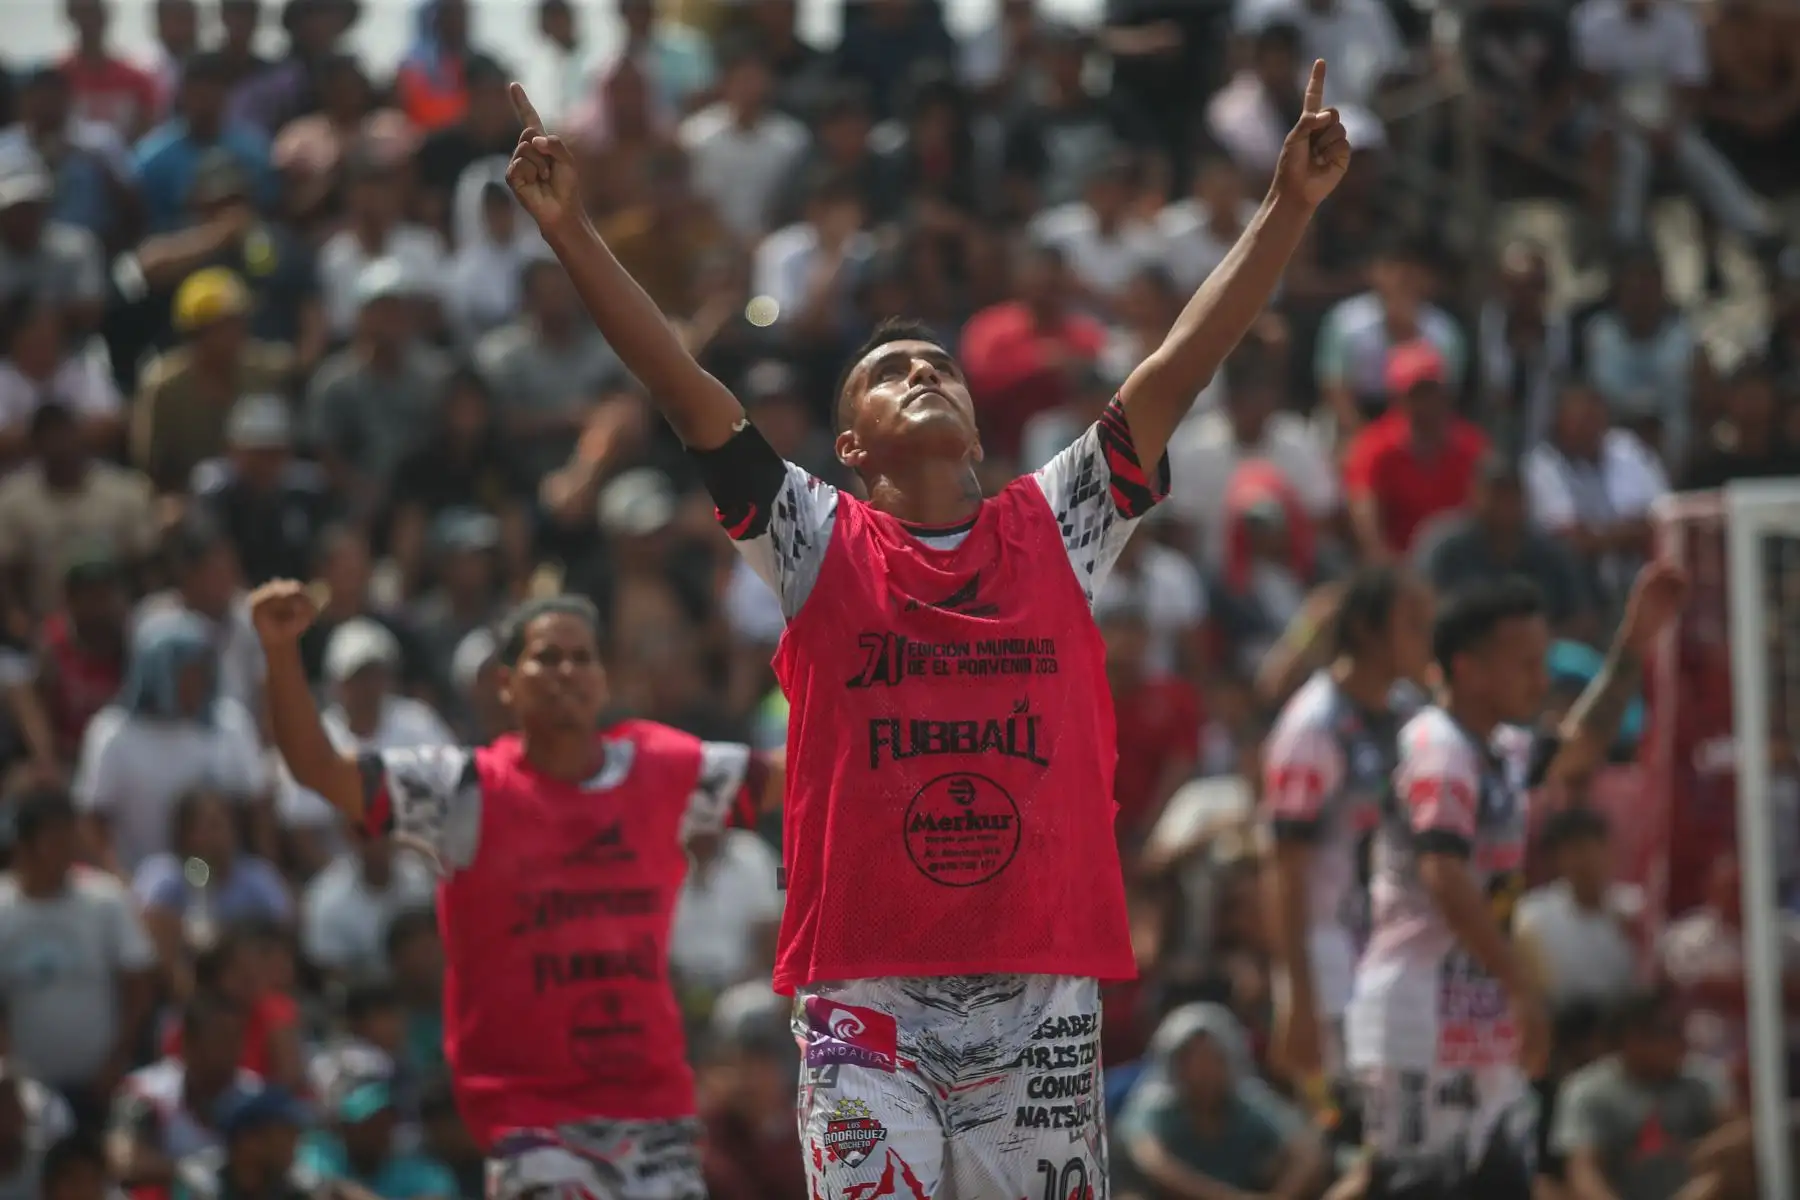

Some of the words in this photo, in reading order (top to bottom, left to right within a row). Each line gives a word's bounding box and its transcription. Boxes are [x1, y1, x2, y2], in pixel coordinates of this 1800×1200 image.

[908, 659, 926, 675] DE
[932, 659, 950, 675] EL
[957, 658, 1031, 675] PORVENIR
[909, 810, 1013, 833] Merkur
[1031, 1013, 1098, 1040] ISABEL
[824, 1129, 885, 1144] RODRIGUEZ
